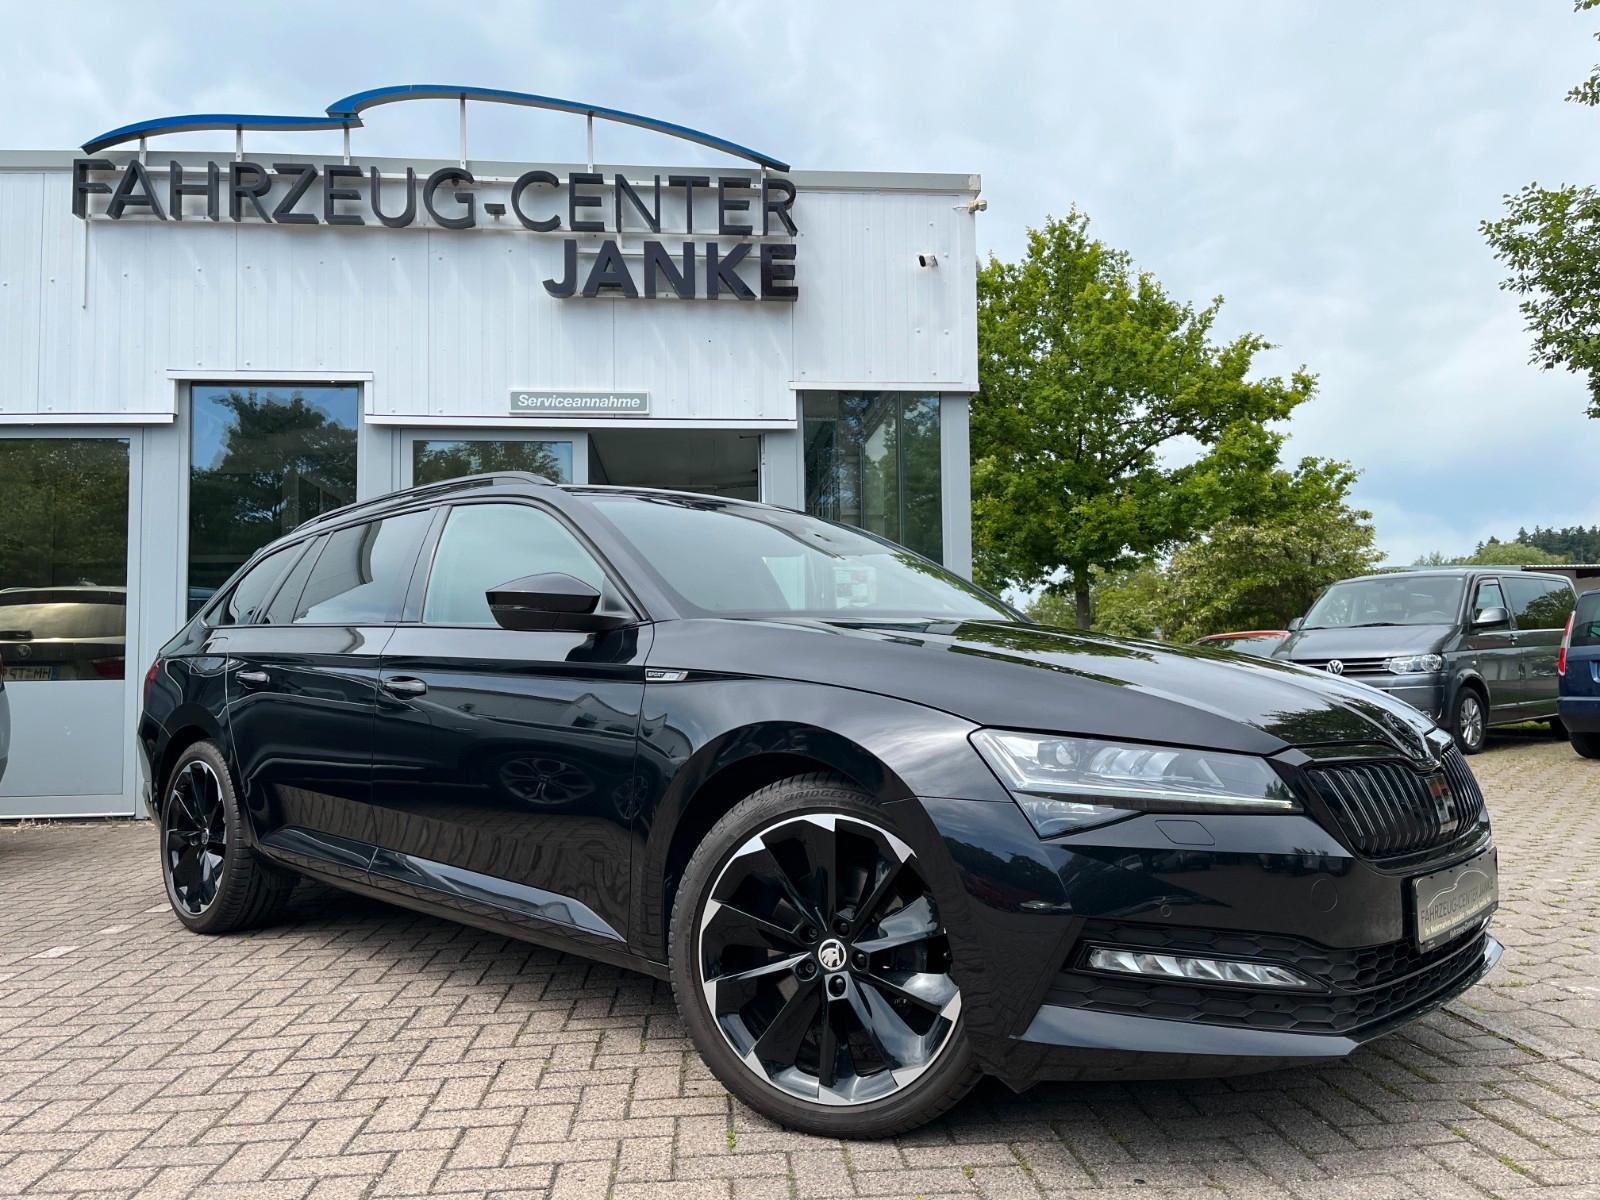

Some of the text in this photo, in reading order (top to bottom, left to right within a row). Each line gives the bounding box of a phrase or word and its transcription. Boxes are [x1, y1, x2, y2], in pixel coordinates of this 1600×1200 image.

[72, 159, 798, 237] FAHRZEUG-CENTER
[542, 239, 798, 301] JANKE
[518, 395, 640, 408] Serviceannahme
